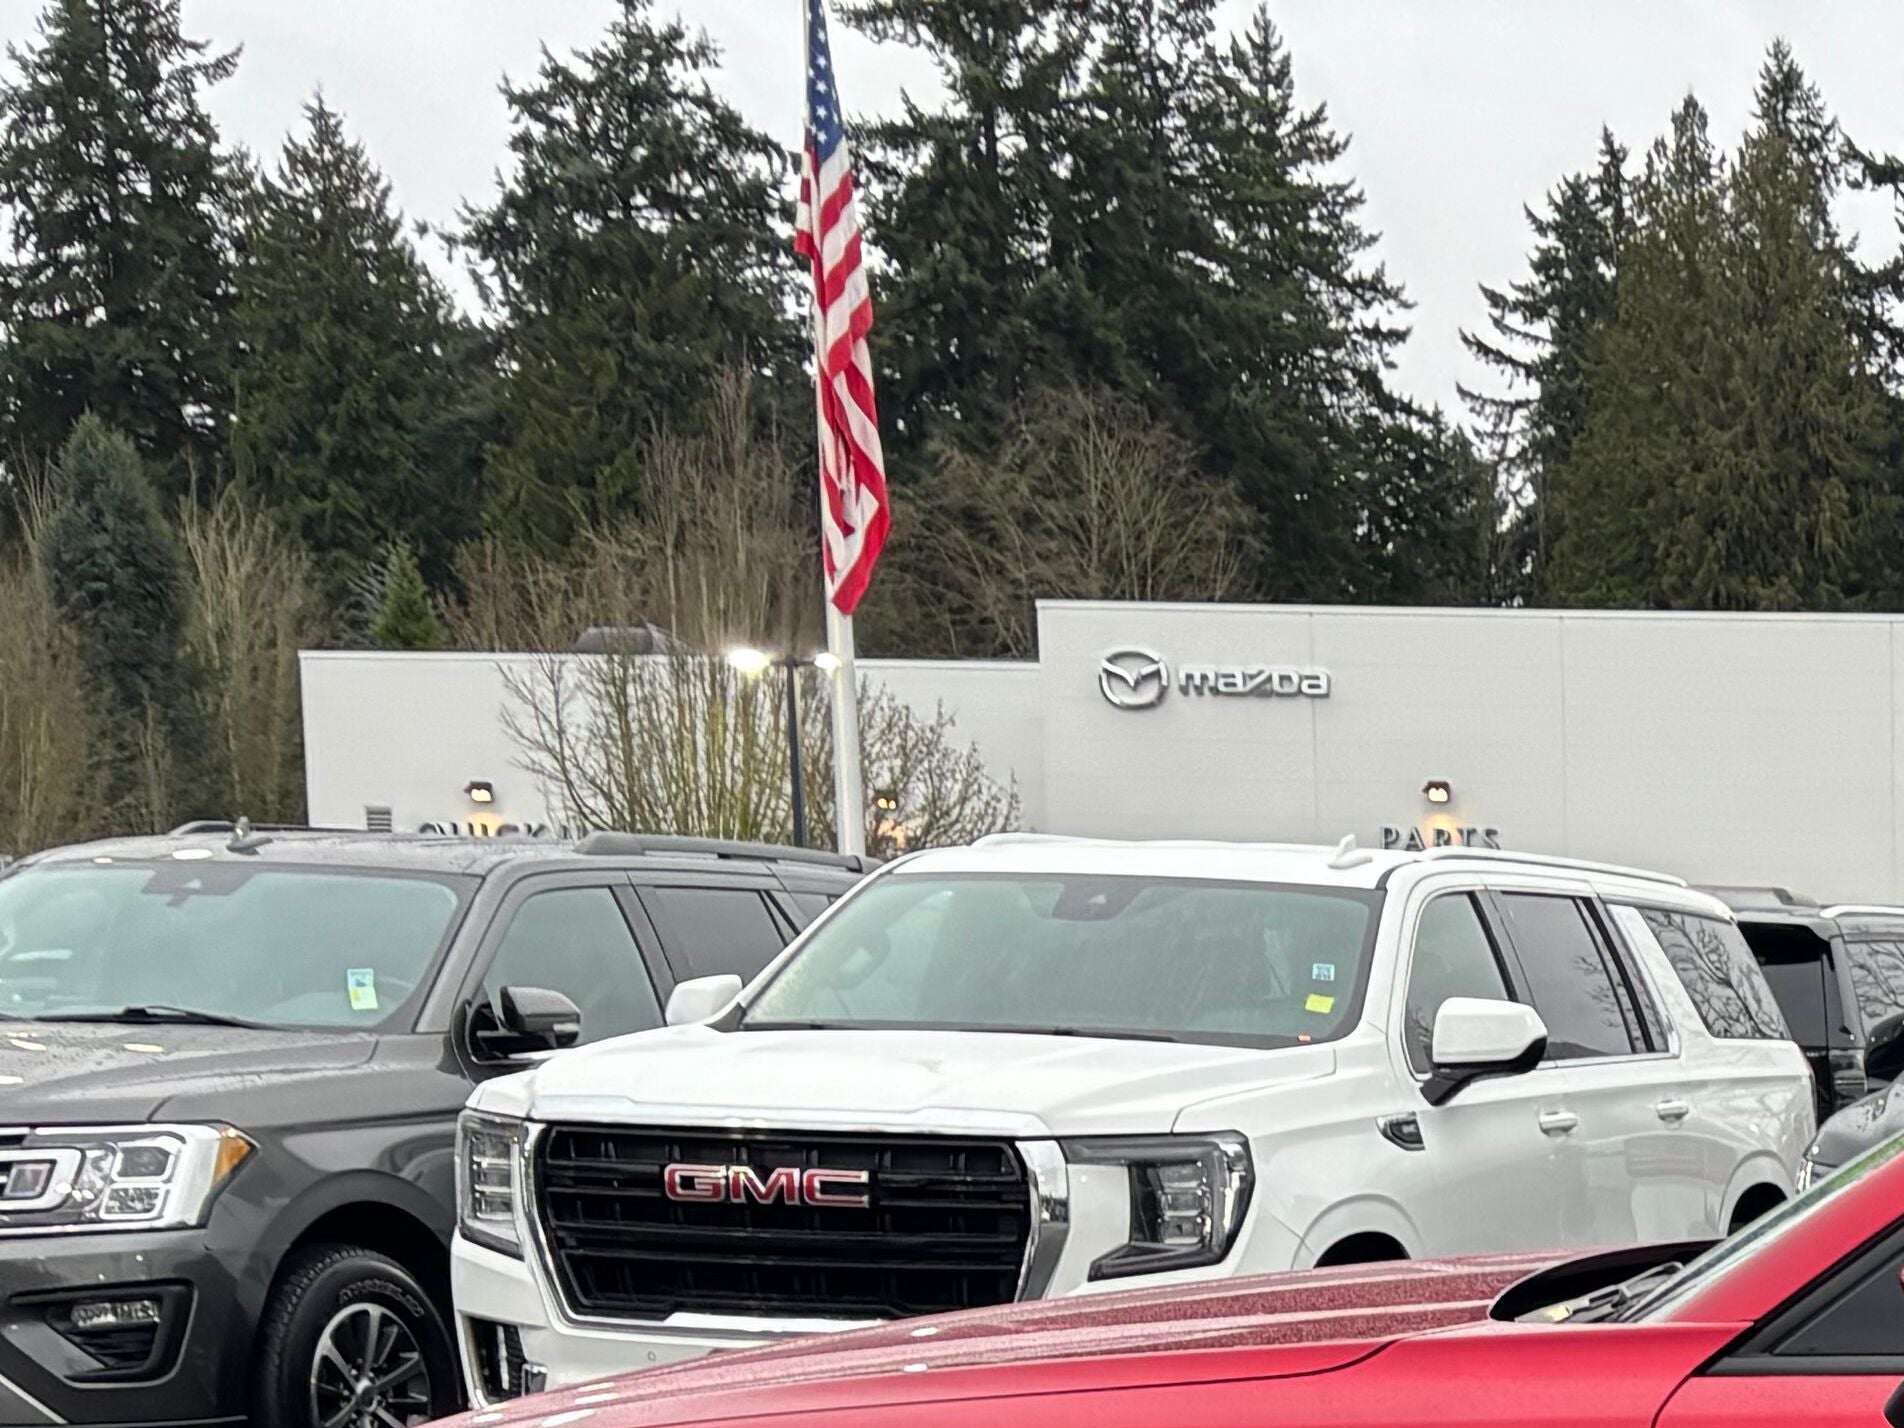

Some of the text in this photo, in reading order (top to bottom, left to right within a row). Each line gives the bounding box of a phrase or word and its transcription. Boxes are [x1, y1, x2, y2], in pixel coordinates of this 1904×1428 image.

[1178, 666, 1330, 698] mazda
[1381, 825, 1502, 852] PARTS
[664, 1162, 870, 1209] GMC
